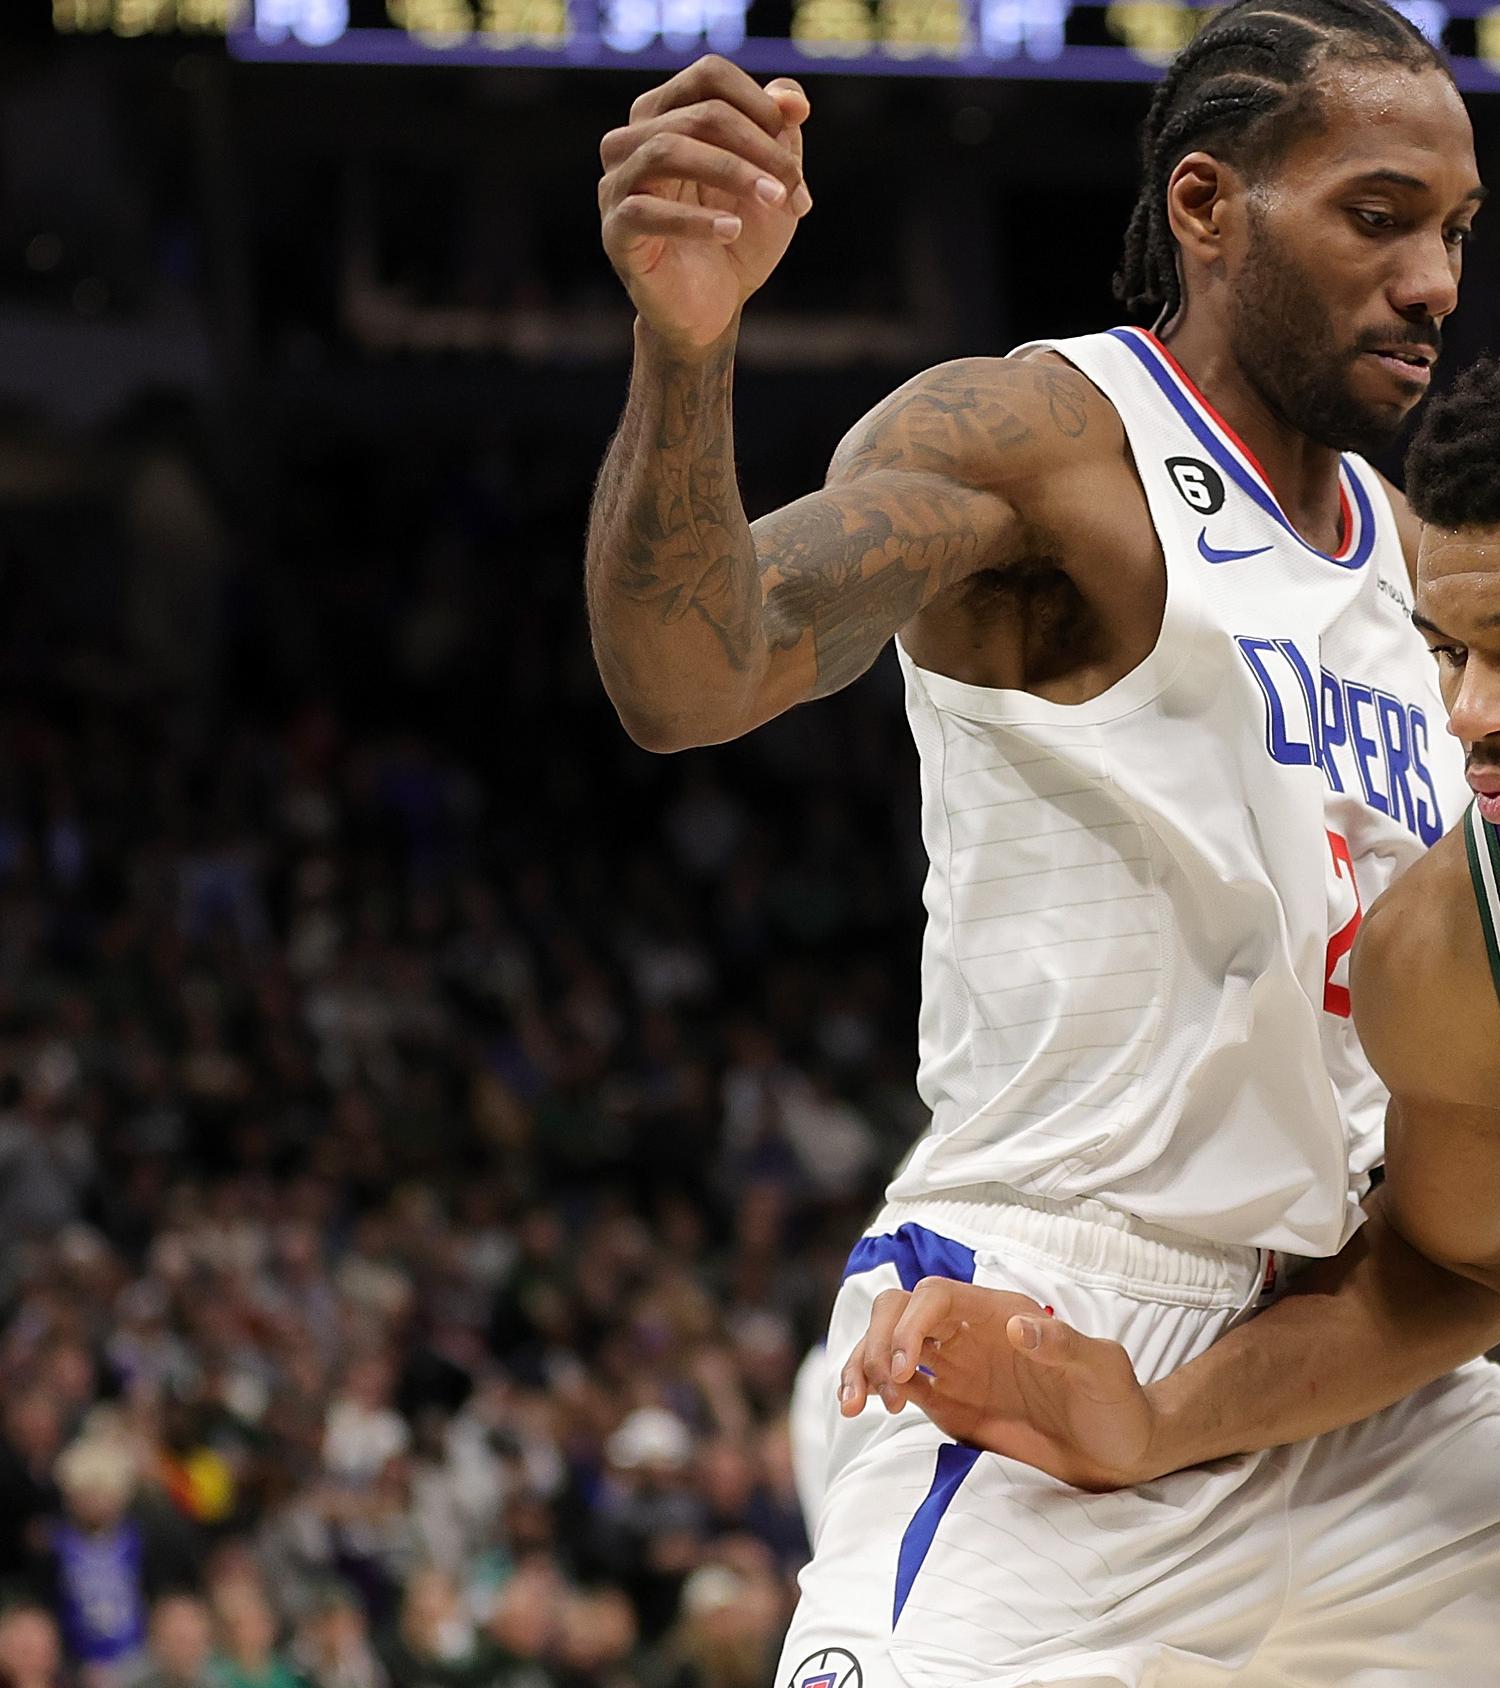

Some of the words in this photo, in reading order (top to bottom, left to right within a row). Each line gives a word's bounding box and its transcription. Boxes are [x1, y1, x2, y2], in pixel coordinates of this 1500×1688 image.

[1173, 464, 1212, 509] 6
[1234, 635, 1444, 848] CLPERS
[1323, 828, 1363, 1019] 2
